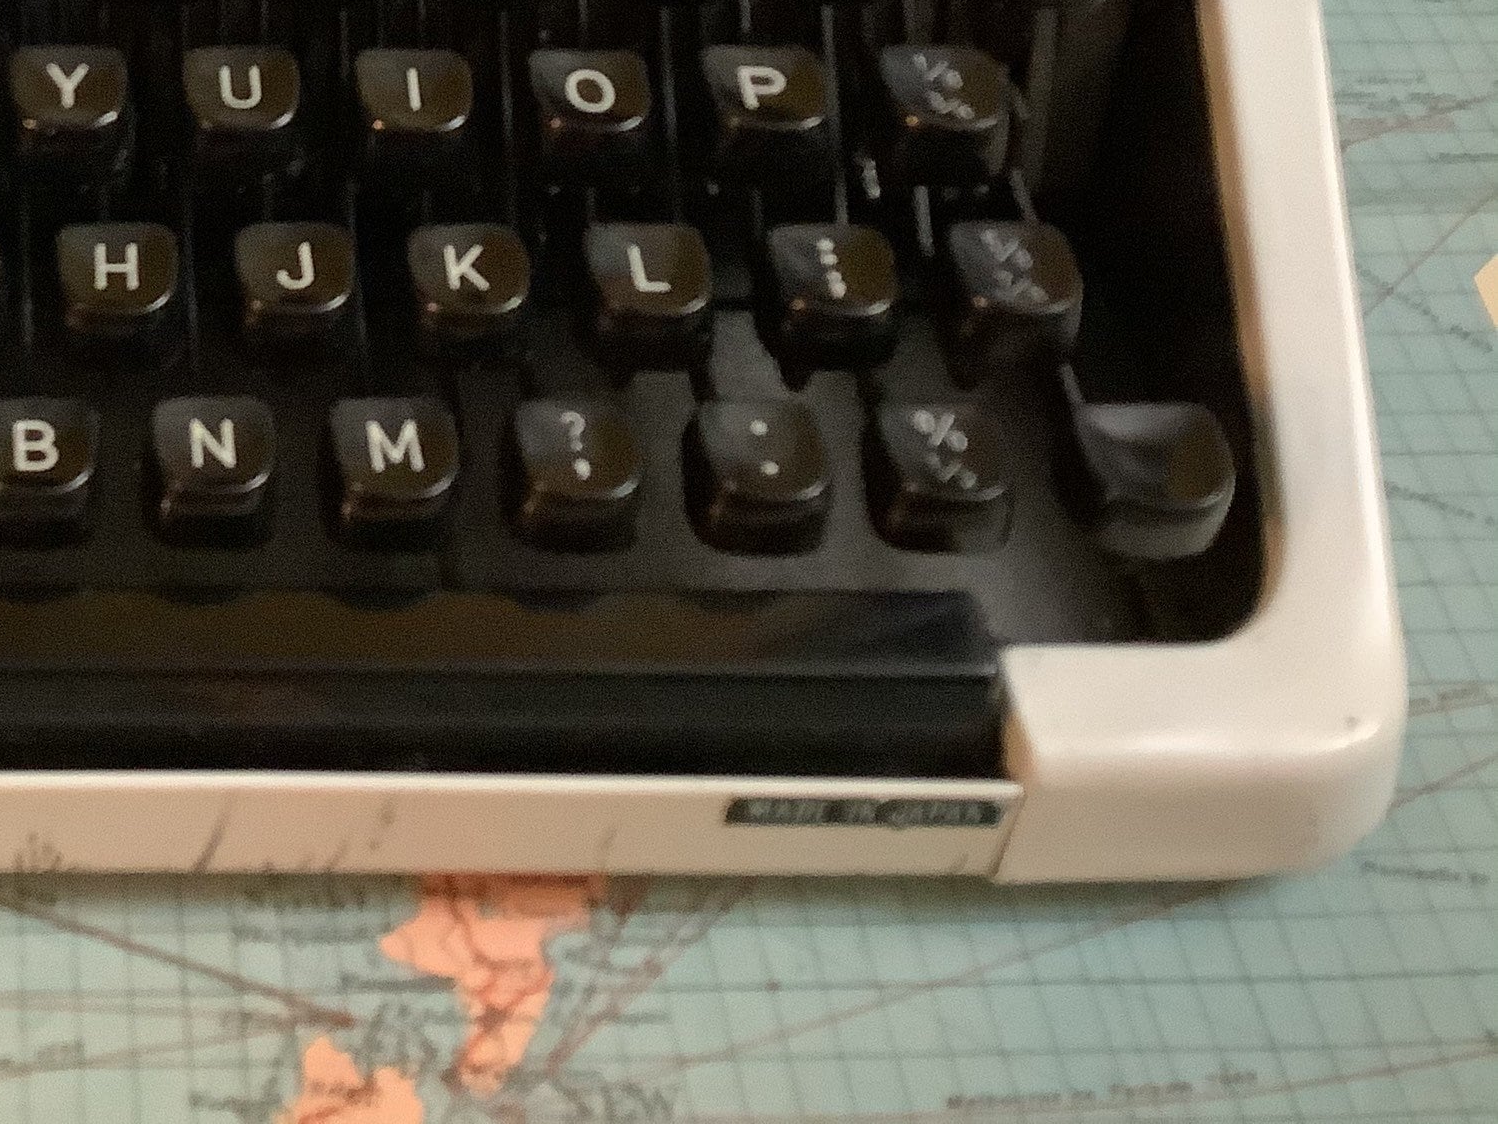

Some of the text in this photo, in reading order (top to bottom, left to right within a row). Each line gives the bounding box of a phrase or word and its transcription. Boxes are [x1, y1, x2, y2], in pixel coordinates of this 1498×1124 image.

[46, 63, 89, 109] Y
[218, 65, 262, 109] U
[406, 68, 421, 111] I
[564, 68, 616, 113] O
[736, 65, 787, 109] P
[93, 243, 139, 290] H
[276, 242, 314, 290] J
[443, 244, 489, 290] K
[626, 244, 671, 293] L
[12, 419, 59, 472] B
[189, 418, 236, 468] N
[365, 419, 424, 472] M
